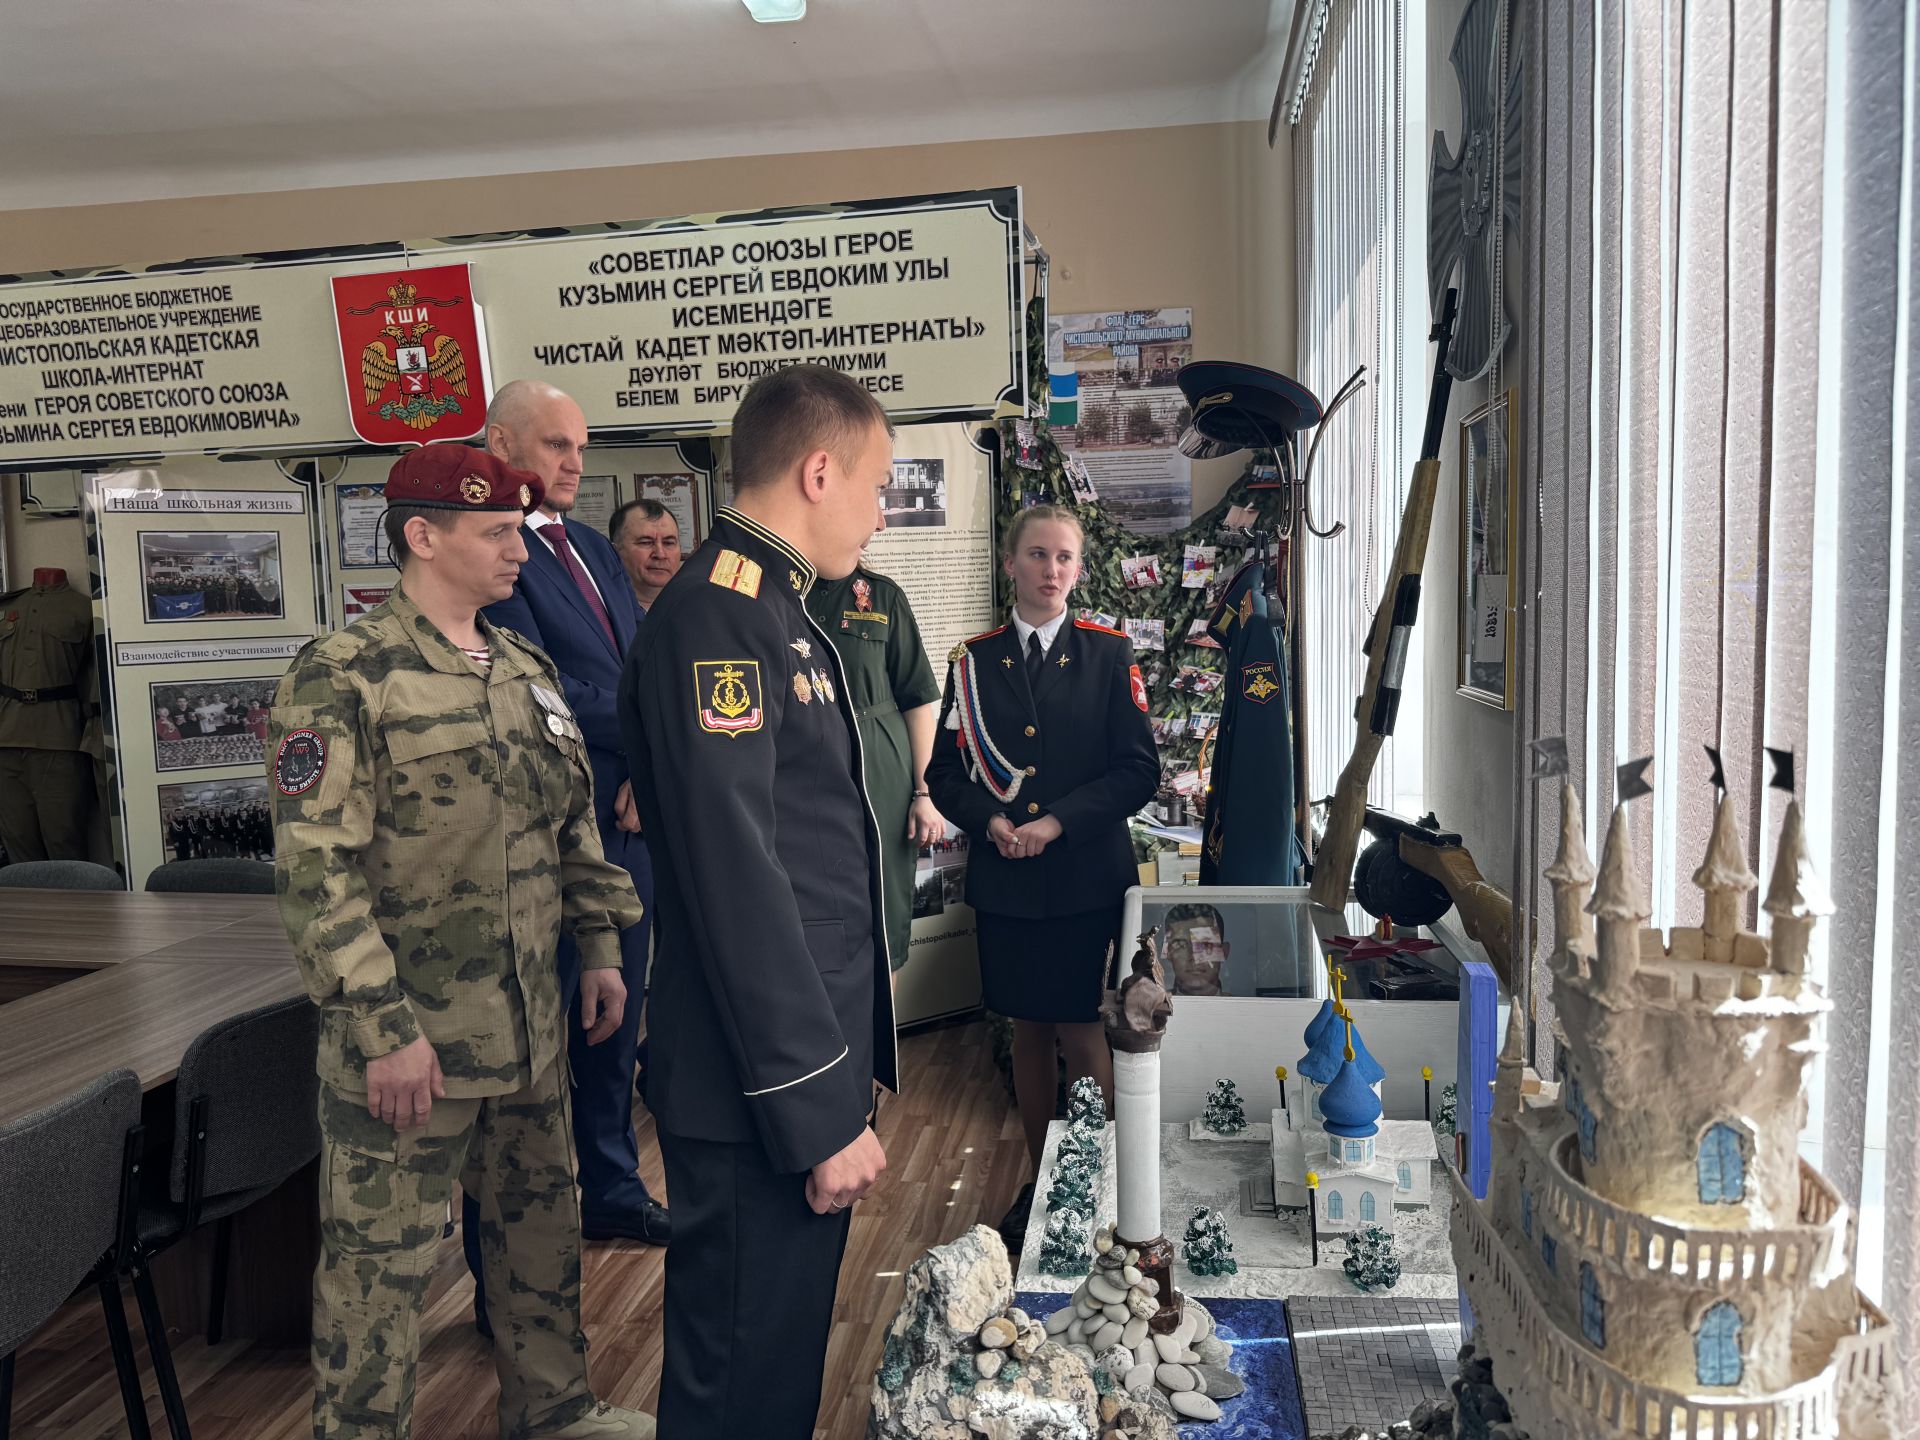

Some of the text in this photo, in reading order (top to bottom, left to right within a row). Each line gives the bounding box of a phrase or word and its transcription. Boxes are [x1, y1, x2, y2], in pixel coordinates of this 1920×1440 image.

[588, 229, 913, 276] «СОВЕТЛАР СОЮЗЫ ГЕРОЕ
[558, 256, 949, 308] КУЗЬМИН СЕРГЕЙ ЕВДОКИМ УЛЫ
[135, 285, 233, 310] БЮДЖЕТНОЕ
[160, 305, 262, 328] УЧРЕЖДЕНИЕ
[384, 307, 429, 325] КШИ
[672, 297, 833, 329] ИСЕМЕНДӘГЕ
[1129, 314, 1145, 325] ГЕРБ
[150, 328, 260, 357] КАДЕТСКАЯ
[533, 316, 986, 366] ЧИСТАЙ КАДЕТ МӘКТӘП-ИНТЕРНАТЫ»
[1064, 326, 1188, 344] ЧИСТОПОЛЬСКОГО МУНИЦИПАЛЬНОГО
[1112, 344, 1139, 356] РАЙОНА
[42, 360, 204, 389] ШКОЛА-ИНТЕРНАТ
[628, 364, 702, 388] ДӘҮЛӘТ
[34, 394, 92, 416] ГЕРОЯ
[95, 386, 215, 412] СОВЕТСКОГО
[219, 381, 289, 404] СОЮЗА
[616, 385, 743, 408] БЕЛЕМ БИРҮ
[68, 418, 136, 440] СЕРГЕЯ
[139, 408, 301, 438] ЕВДОКИМОВИЧА»
[113, 497, 293, 510] Наша школьная жизнь
[121, 648, 210, 662] Взаимодействие
[218, 647, 284, 658] участниками
[1245, 665, 1272, 676] РОССИЯ
[288, 732, 313, 742] WAGNER
